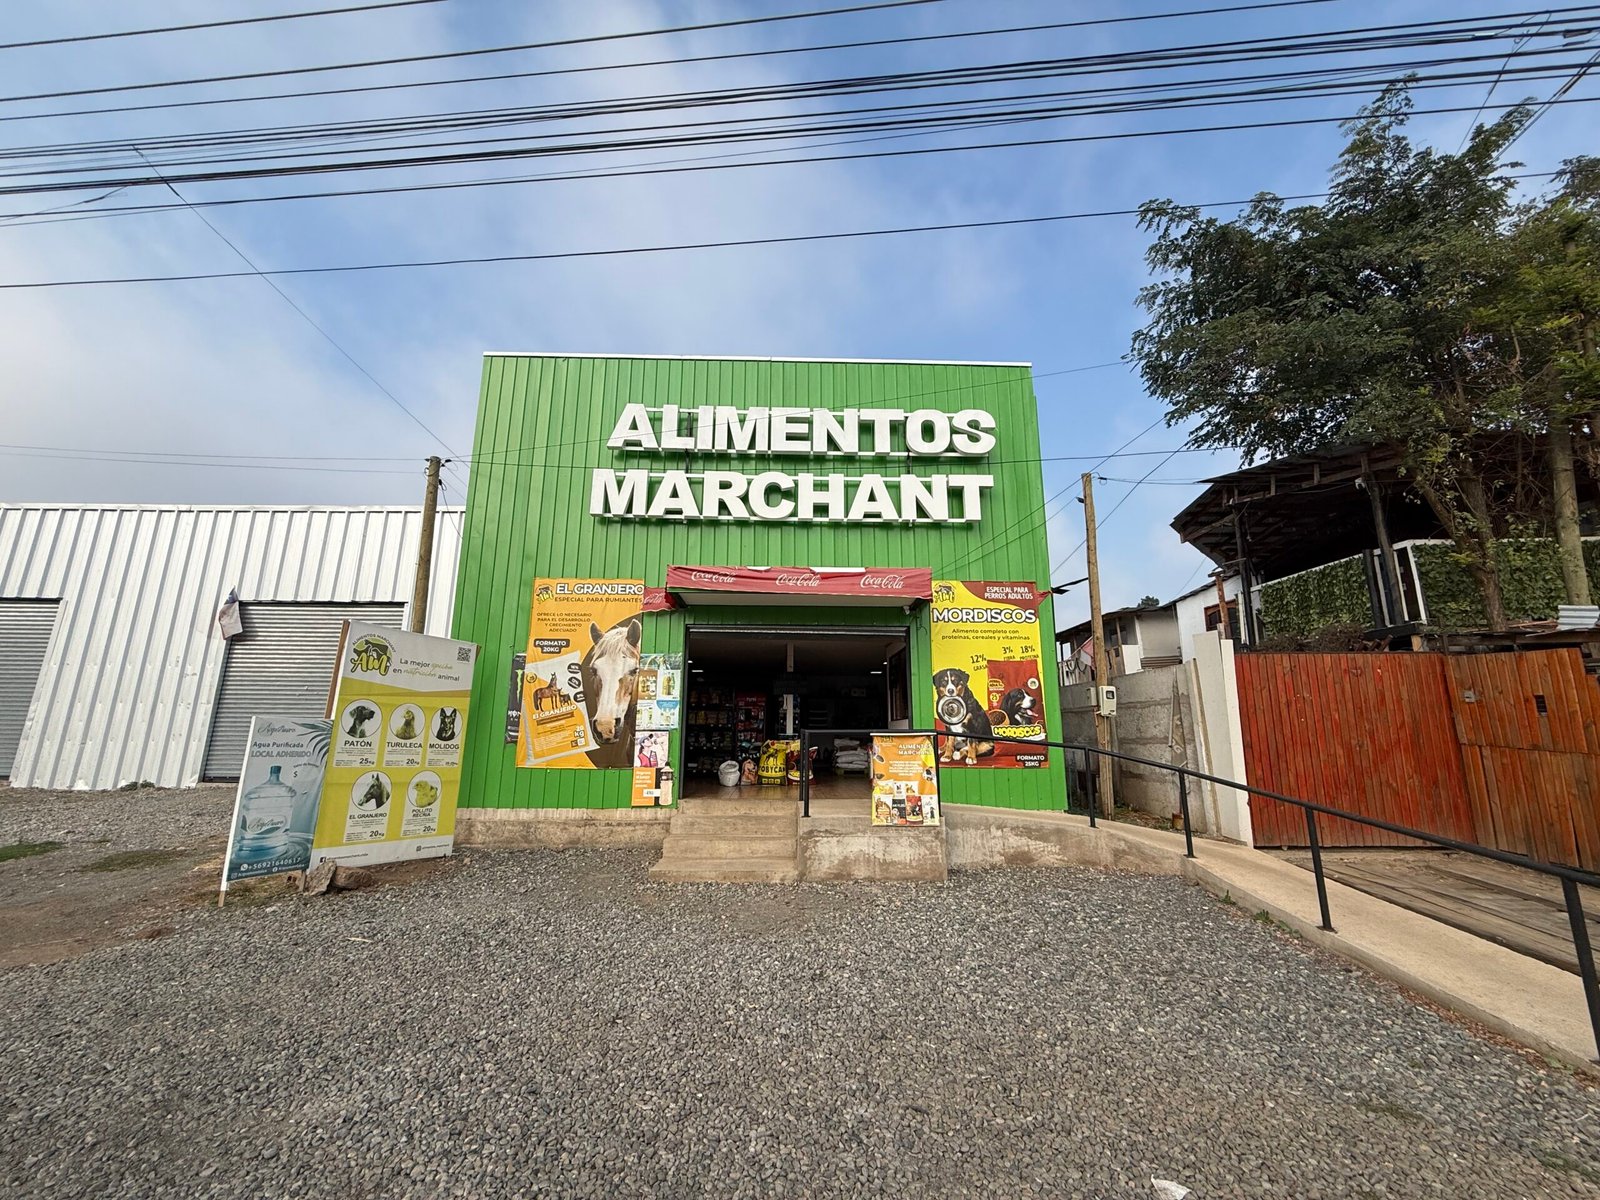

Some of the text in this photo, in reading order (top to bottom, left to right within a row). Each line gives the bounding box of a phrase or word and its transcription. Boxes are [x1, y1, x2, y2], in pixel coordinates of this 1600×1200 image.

[606, 402, 997, 456] ALIMENTOS
[590, 468, 993, 522] MARCHANT
[776, 573, 821, 587] Coca-Cola
[860, 574, 905, 589] Coca-Cola
[555, 583, 644, 595] EL GRANJERO
[932, 608, 1037, 624] MORDISCOS
[1002, 645, 1035, 654] 3% 18%
[400, 657, 409, 665] La
[409, 660, 430, 669] mejor
[970, 654, 987, 664] 12%
[437, 673, 460, 682] animal
[539, 704, 577, 717] GRANJERO
[993, 725, 1041, 738] MORDISCOS
[253, 741, 271, 749] Agua
[344, 739, 372, 748] PATÓN
[387, 741, 423, 749] TURULECA
[251, 750, 311, 758] LOCAL ADHERIDO
